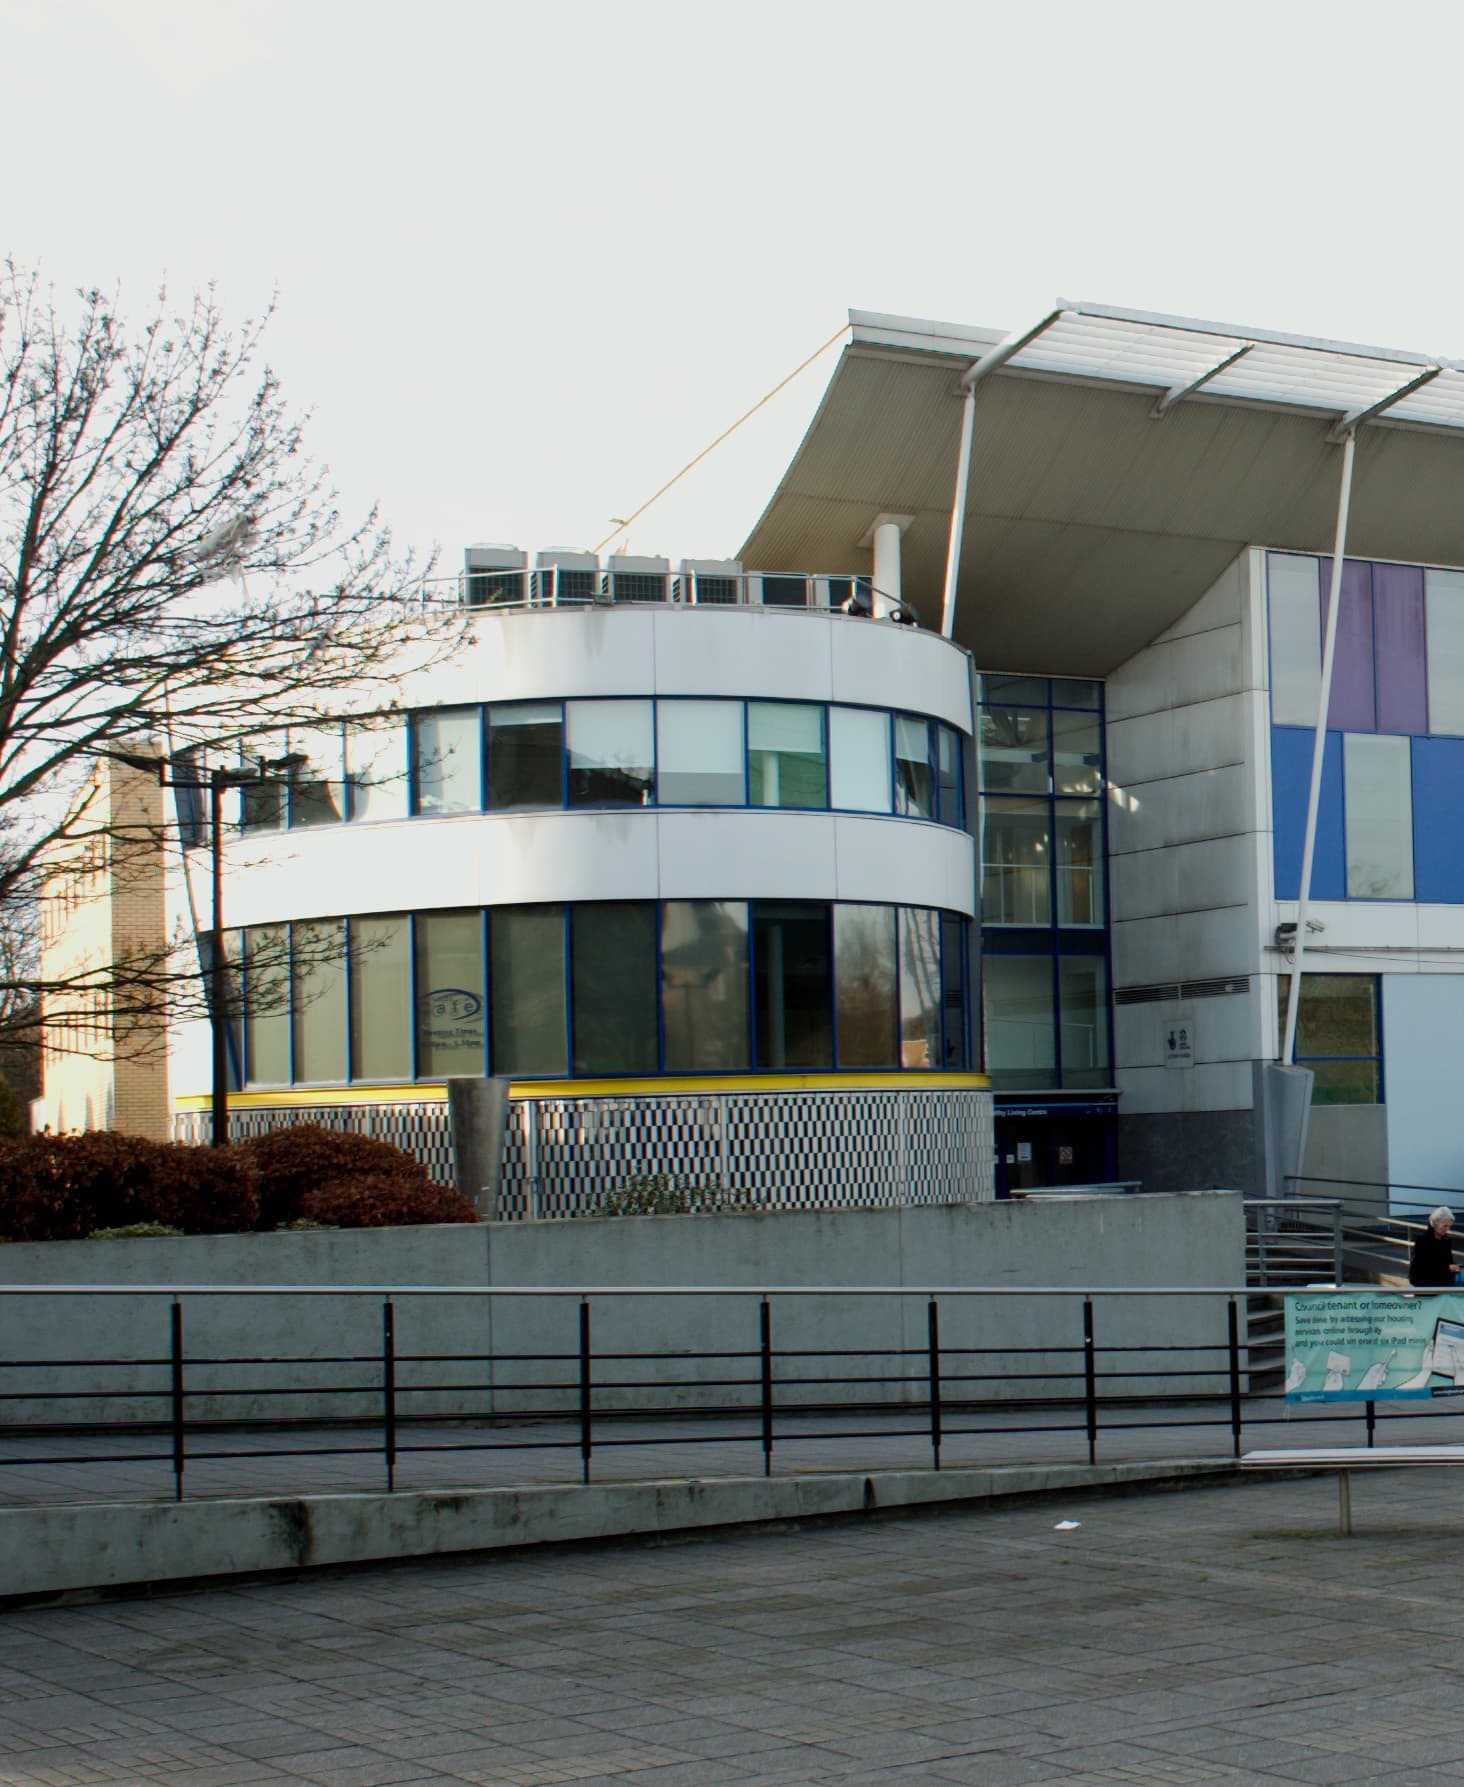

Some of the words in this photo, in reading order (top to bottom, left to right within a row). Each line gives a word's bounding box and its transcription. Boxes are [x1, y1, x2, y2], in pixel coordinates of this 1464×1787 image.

[1295, 1300, 1326, 1311] Council
[1327, 1300, 1357, 1311] tenant
[1360, 1302, 1370, 1310] or
[1387, 1314, 1414, 1325] housing
[1325, 1338, 1345, 1346] could
[1391, 1336, 1407, 1345] iPad
